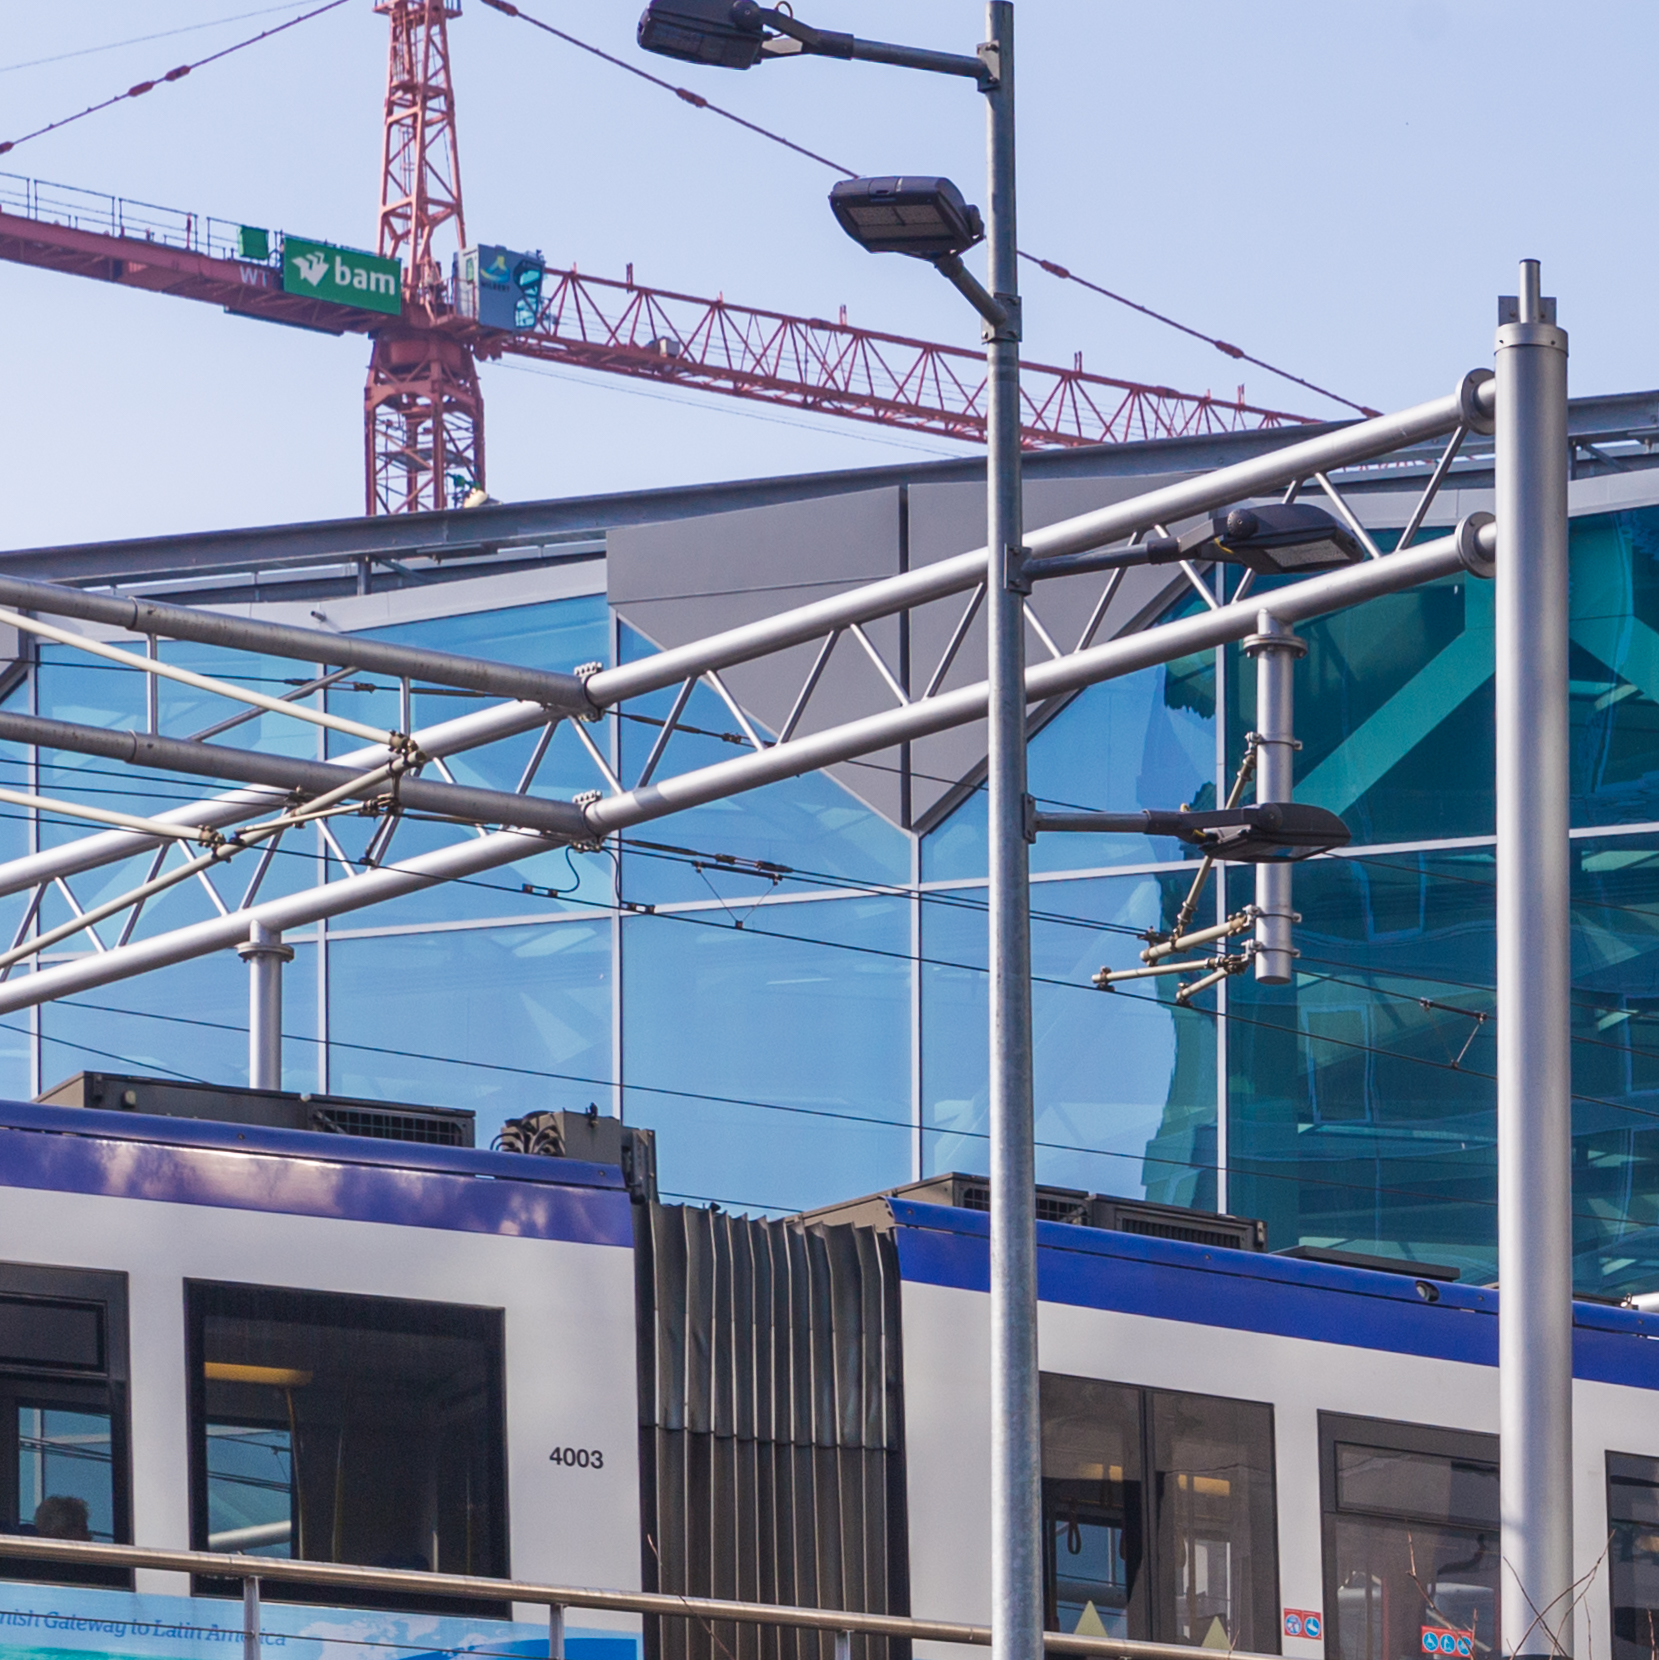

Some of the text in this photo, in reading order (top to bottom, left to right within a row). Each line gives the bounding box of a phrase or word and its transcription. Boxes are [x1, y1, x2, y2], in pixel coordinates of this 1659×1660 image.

[335, 256, 395, 295] bam
[550, 1447, 604, 1469] 4003
[44, 1611, 126, 1637] Gateway
[131, 1619, 150, 1635] to
[153, 1620, 202, 1639] Latin
[206, 1624, 286, 1646] Amica
